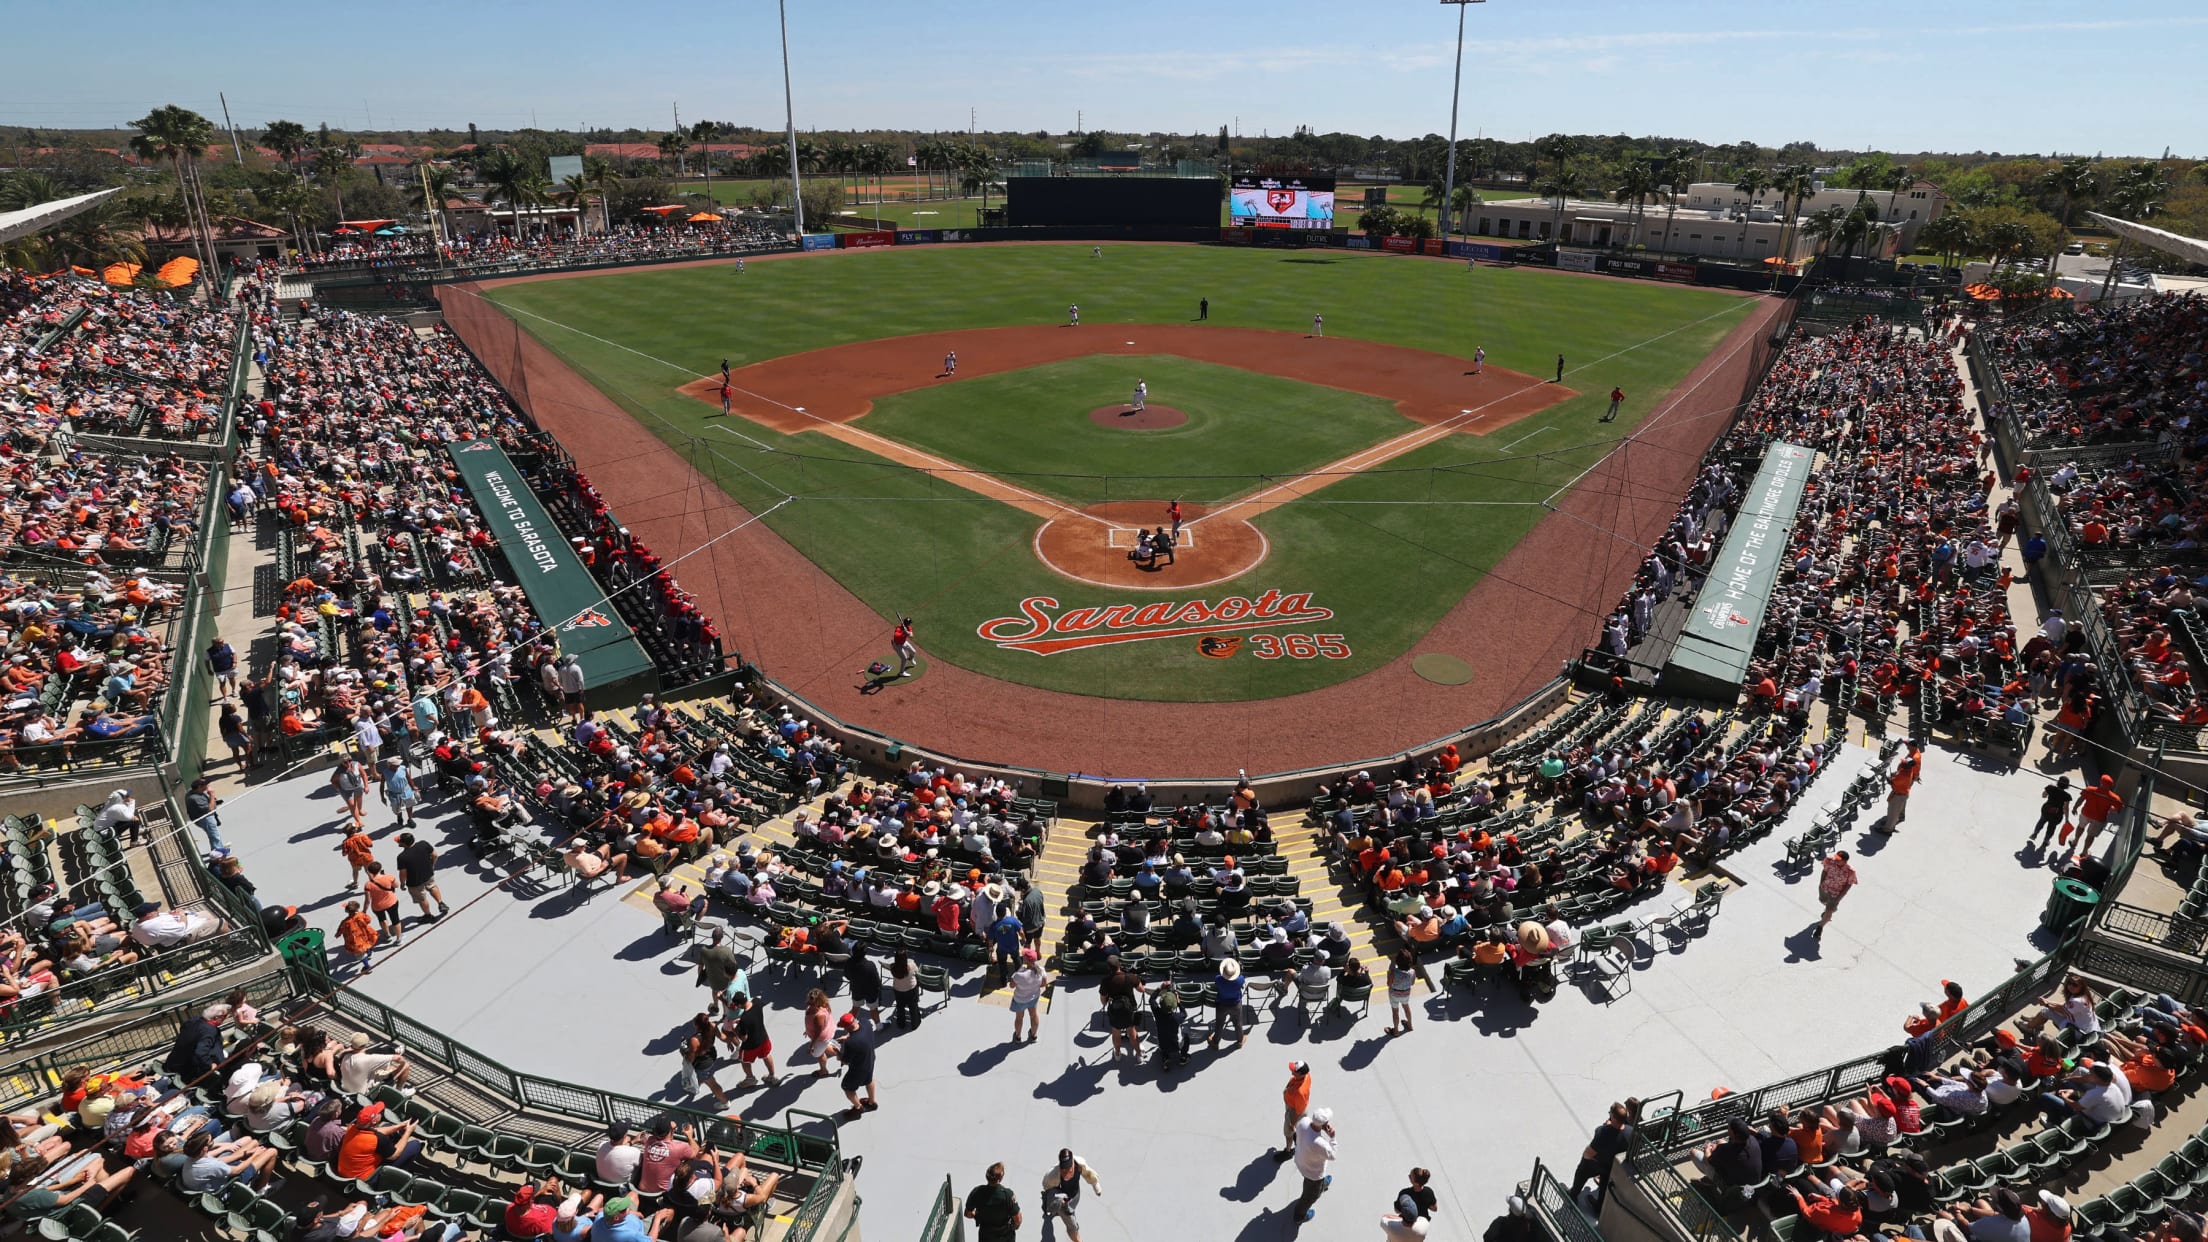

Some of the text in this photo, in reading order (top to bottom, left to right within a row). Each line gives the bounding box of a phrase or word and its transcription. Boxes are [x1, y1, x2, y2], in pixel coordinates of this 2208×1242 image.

[902, 233, 914, 241] FLY
[1608, 259, 1623, 269] FIRST
[484, 470, 558, 574] WELCOME TO SARASOTA
[1754, 488, 1783, 531] BALTIMORE
[1749, 529, 1766, 551] THE
[1741, 547, 1758, 566] OF
[1726, 566, 1752, 600] HOME
[976, 589, 1334, 648] Sarasota
[1249, 634, 1352, 659] 365
